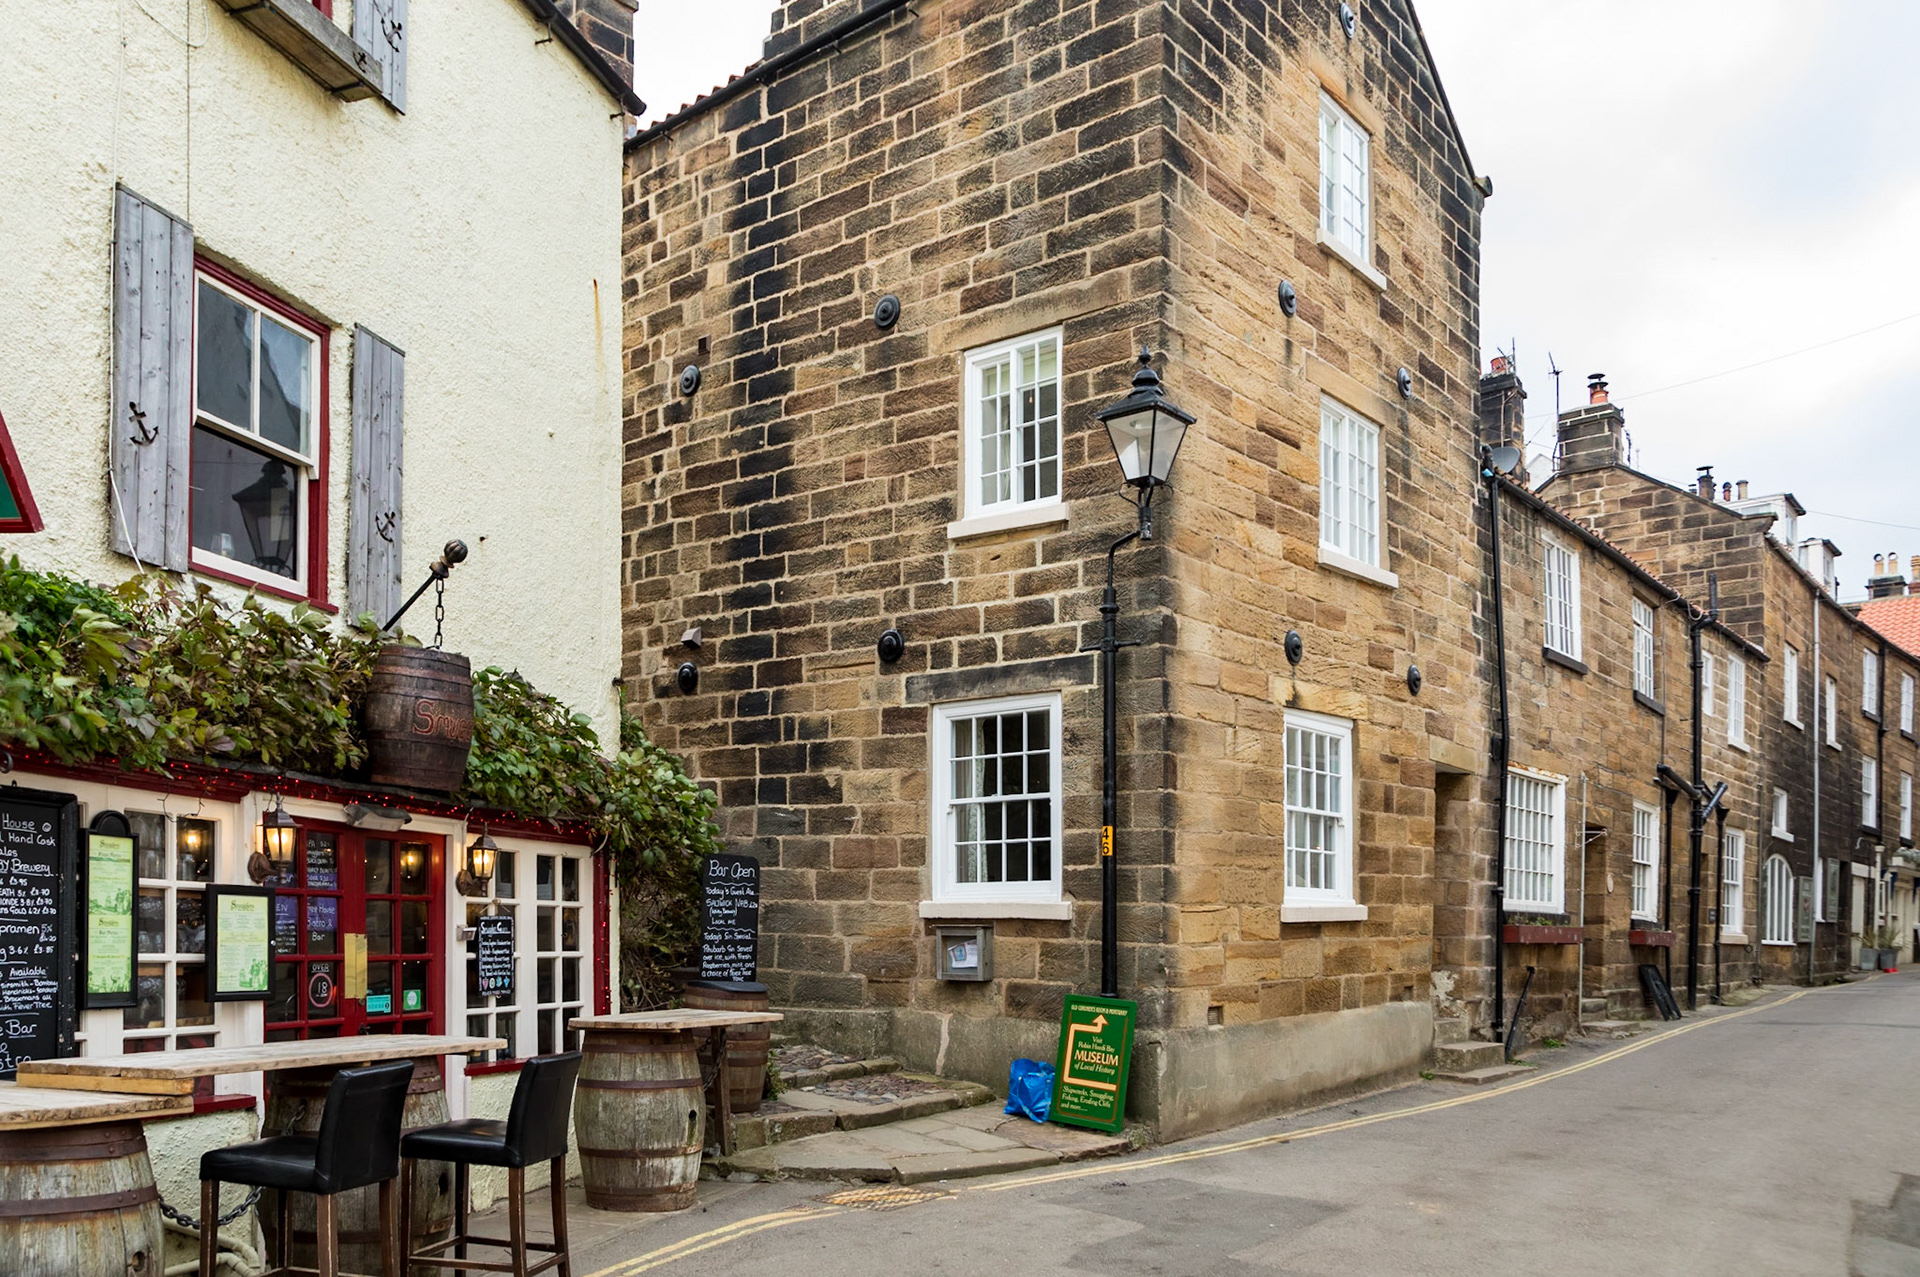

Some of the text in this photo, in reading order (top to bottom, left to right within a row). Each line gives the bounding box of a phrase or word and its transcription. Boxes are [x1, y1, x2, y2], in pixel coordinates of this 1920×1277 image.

[2, 813, 35, 830] House
[8, 832, 33, 844] Hand
[708, 859, 755, 880] Bar Open
[312, 931, 326, 942] Bar
[317, 981, 328, 994] 18
[5, 1019, 37, 1036] Bar
[1074, 1049, 1118, 1066] MUSEUM
[1080, 1062, 1096, 1072] Local
[1095, 1064, 1115, 1075] History
